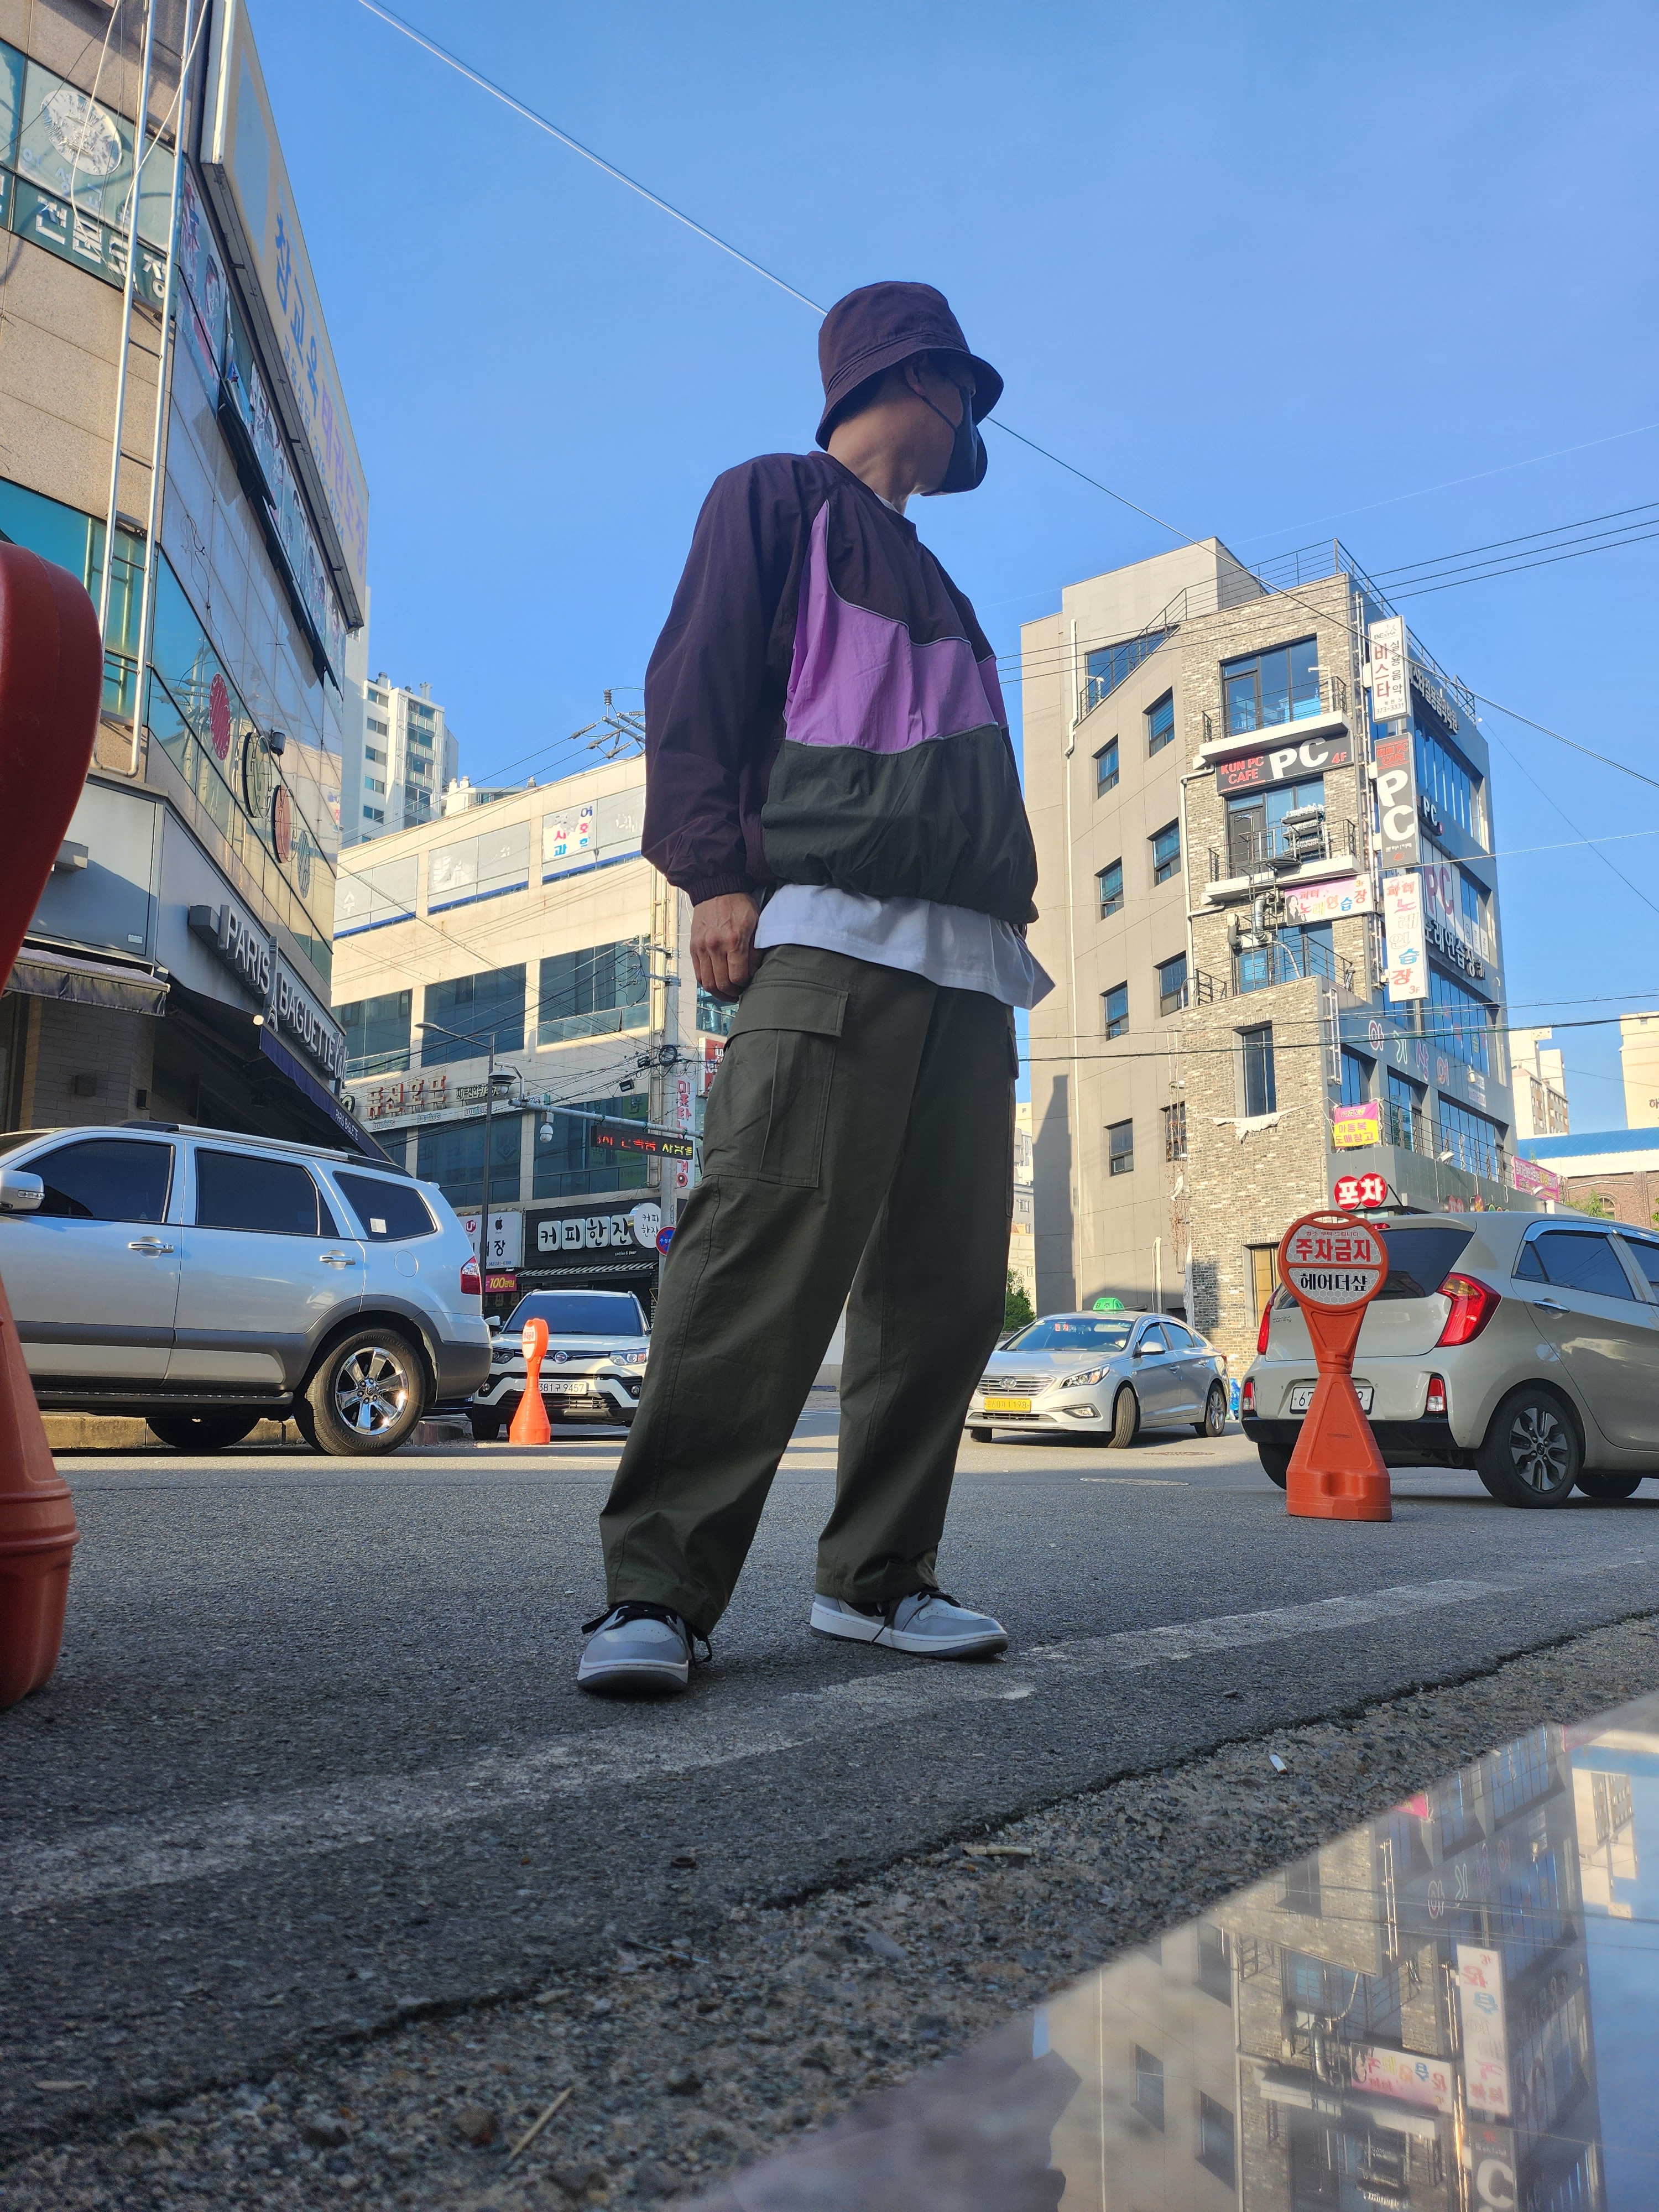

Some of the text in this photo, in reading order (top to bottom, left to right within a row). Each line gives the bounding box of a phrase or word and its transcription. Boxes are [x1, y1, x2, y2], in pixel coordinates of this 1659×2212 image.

[1374, 643, 1391, 697] 비스타
[1390, 640, 1403, 695] 실용음악
[1376, 702, 1404, 714] 373-3331
[1269, 737, 1347, 779] PC 4F
[1377, 743, 1408, 758] KUN PC
[1382, 752, 1405, 765] CAFE
[1221, 756, 1264, 775] KUN PC
[1228, 768, 1259, 784] CAFE
[1376, 769, 1415, 841] PC
[1423, 795, 1438, 826] PC
[1423, 865, 1454, 915] PC
[1300, 889, 1368, 916] 노래연습장
[1389, 899, 1420, 985] 노래연습장
[220, 906, 270, 995] PARIS
[278, 972, 335, 1072] BAGUETTE
[1409, 985, 1421, 994] 3F
[1369, 1020, 1450, 1086] 아기상어
[372, 1119, 395, 1131] luxurious
[417, 1112, 441, 1124] luxurious
[1339, 1122, 1366, 1133] 아동복
[1335, 1132, 1374, 1144] 도매창고
[1338, 1178, 1384, 1204] 포차
[642, 1213, 659, 1223] 커피
[1296, 1238, 1371, 1262] 주차금지
[1300, 1273, 1368, 1292] 헤어더샾
[539, 1383, 585, 1392] 381구 9457
